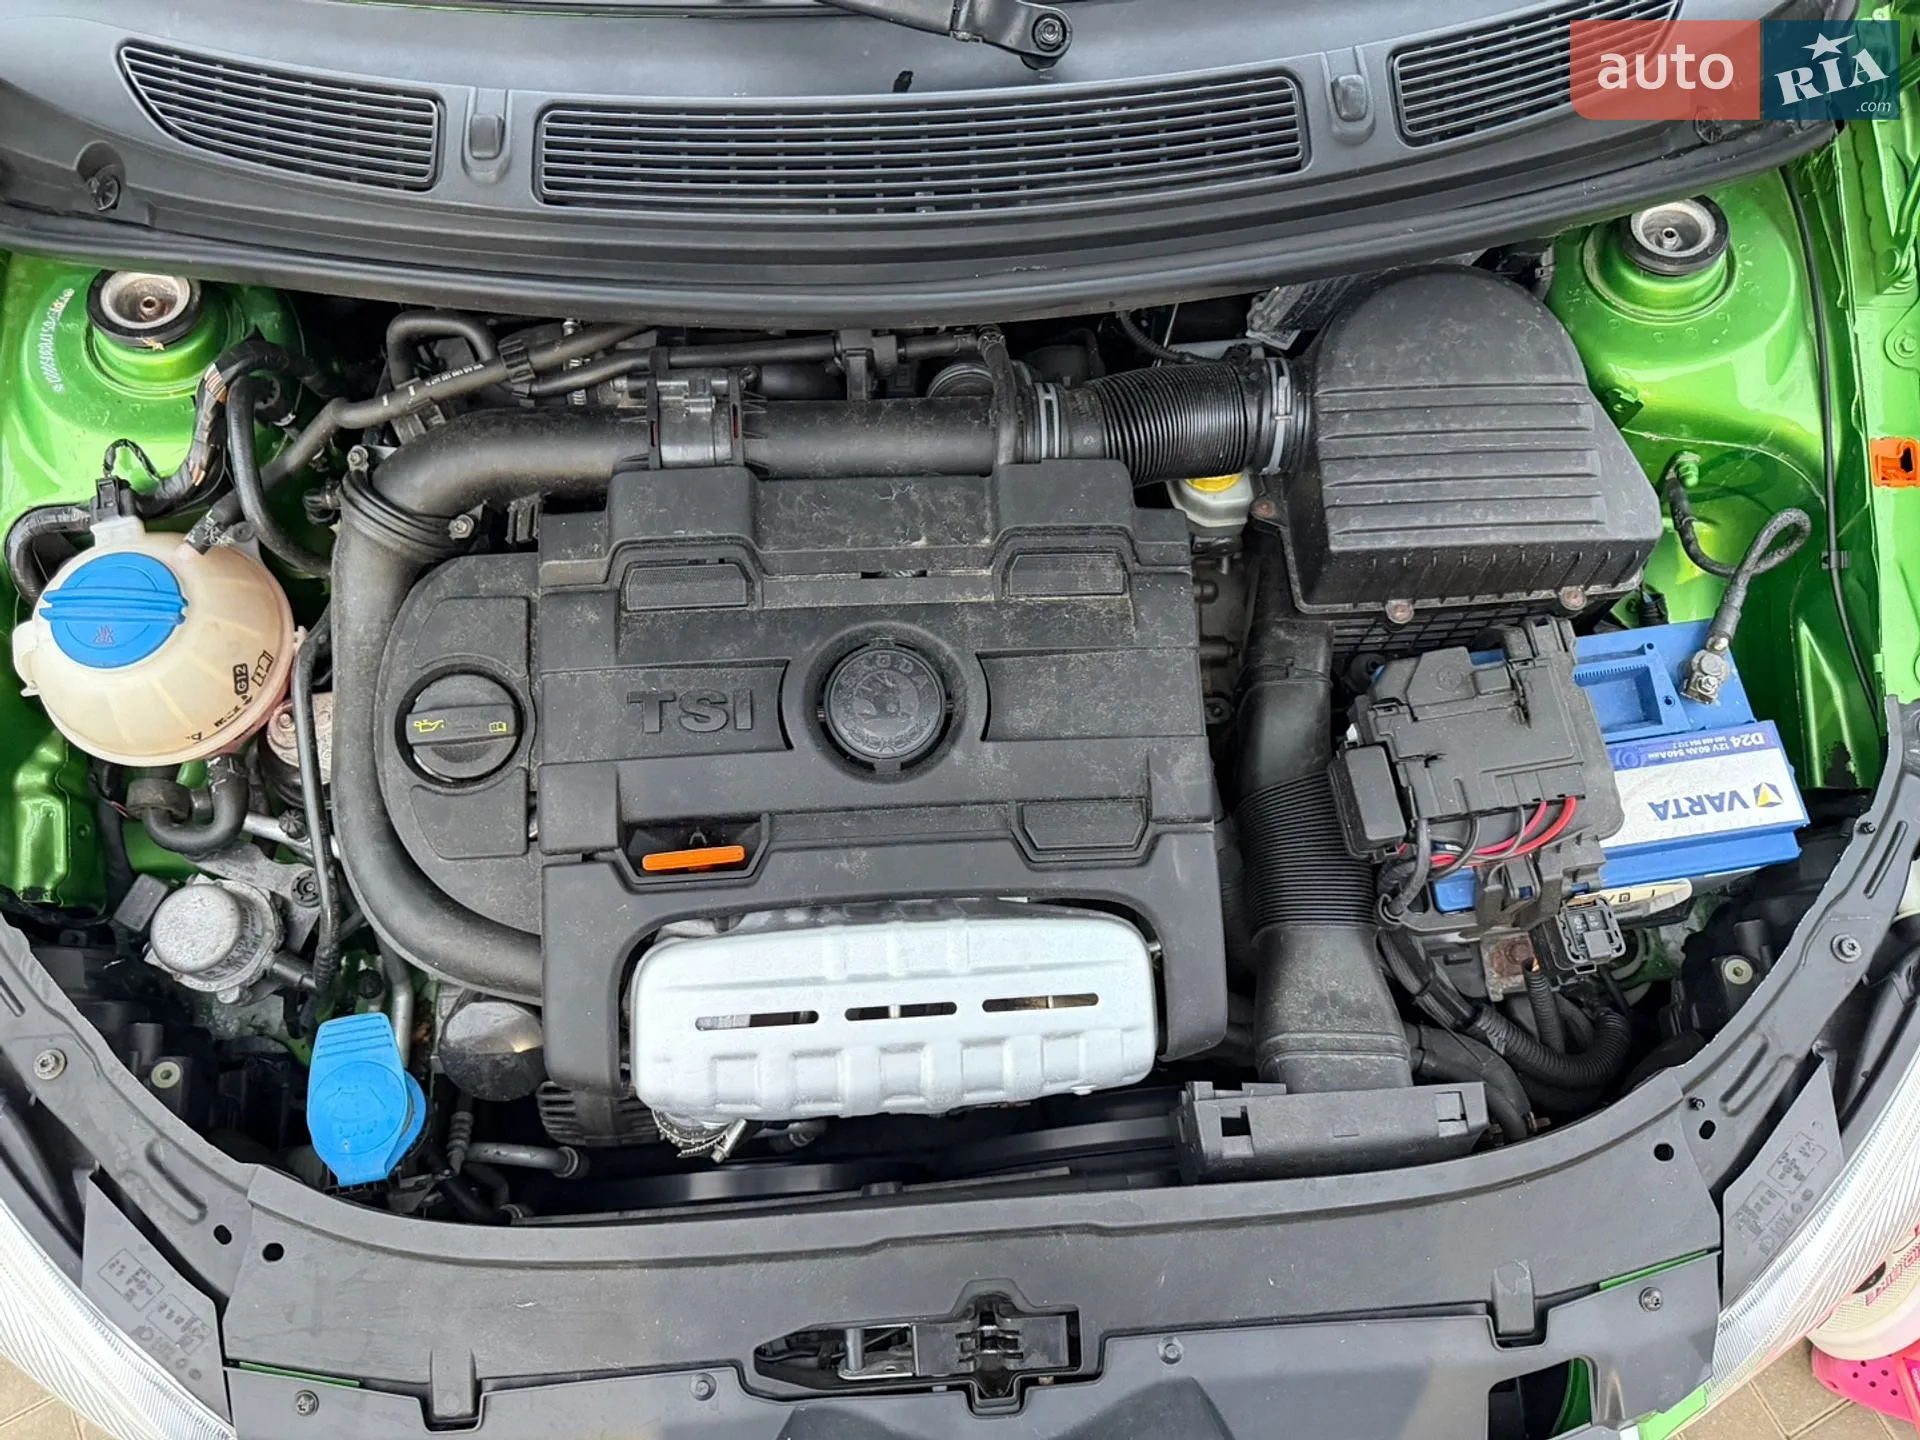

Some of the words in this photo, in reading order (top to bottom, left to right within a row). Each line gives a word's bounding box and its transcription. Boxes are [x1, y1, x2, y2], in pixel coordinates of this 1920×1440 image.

[626, 687, 754, 735] TSI
[1712, 742, 1730, 753] 12V
[1730, 731, 1766, 748] D24
[1647, 789, 1750, 822] VARTA
